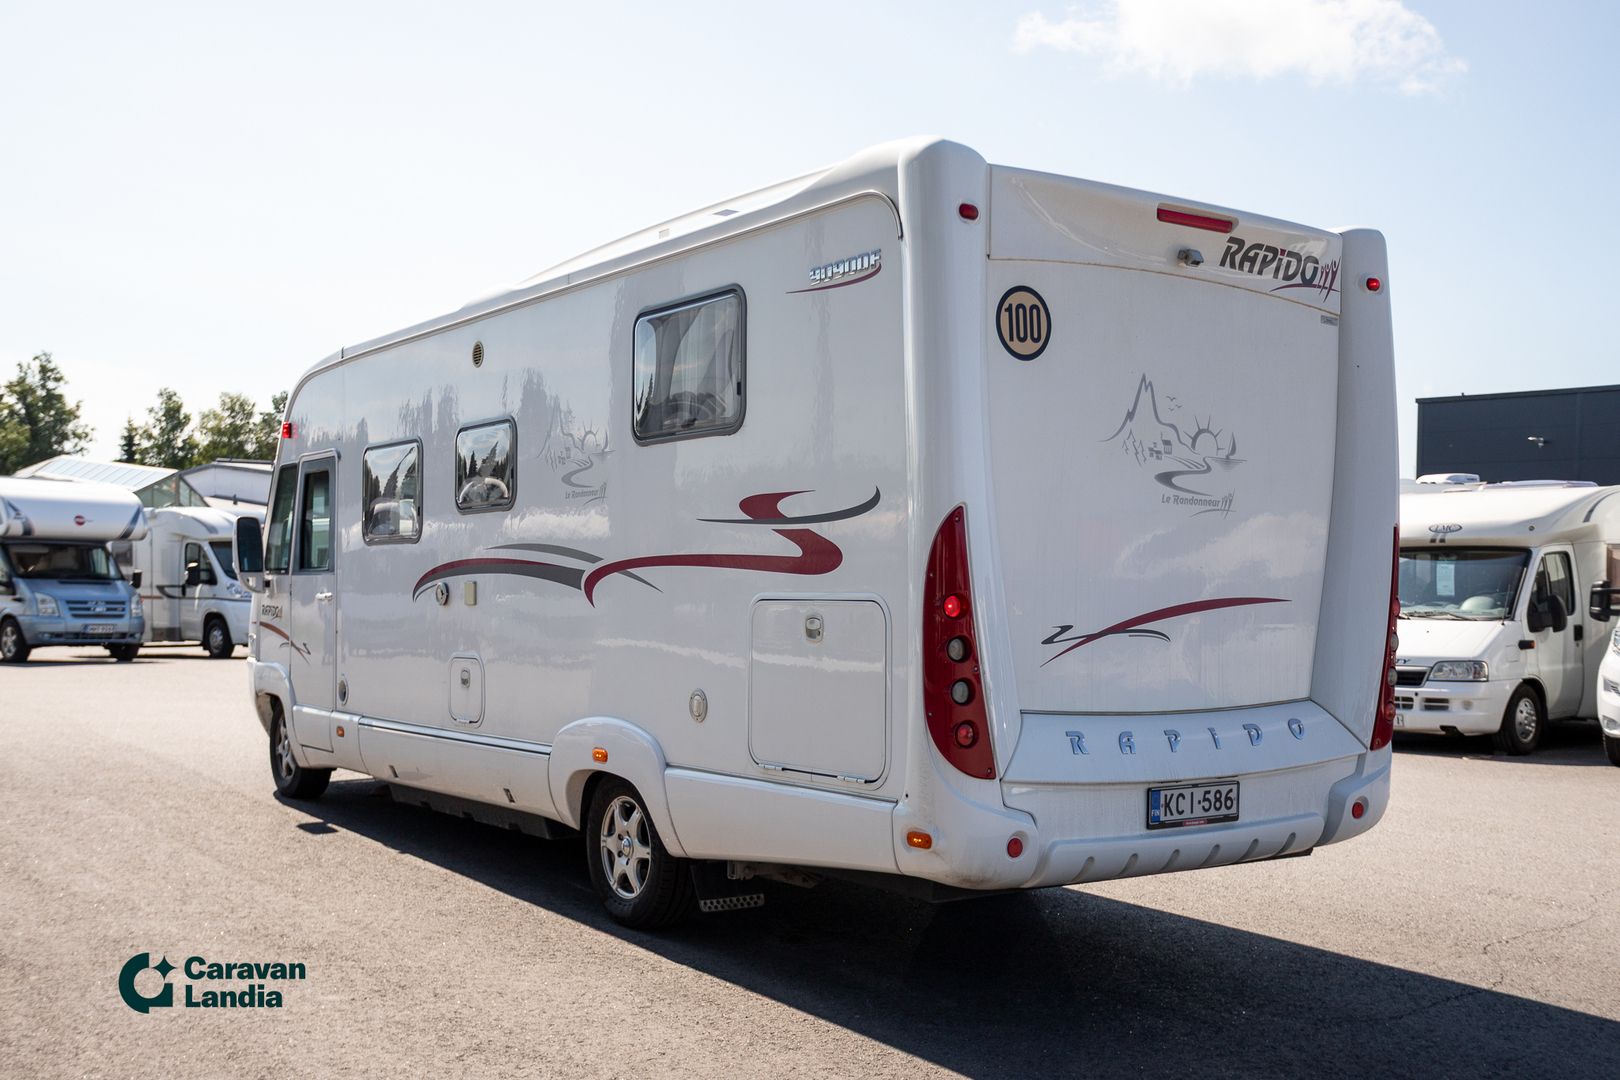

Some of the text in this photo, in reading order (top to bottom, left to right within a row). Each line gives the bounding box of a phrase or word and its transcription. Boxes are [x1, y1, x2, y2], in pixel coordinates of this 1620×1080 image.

[1004, 303, 1042, 343] 100
[1161, 494, 1221, 507] Le Randonneur
[1066, 718, 1305, 755] RAPIDO
[1163, 788, 1234, 817] KCI-586
